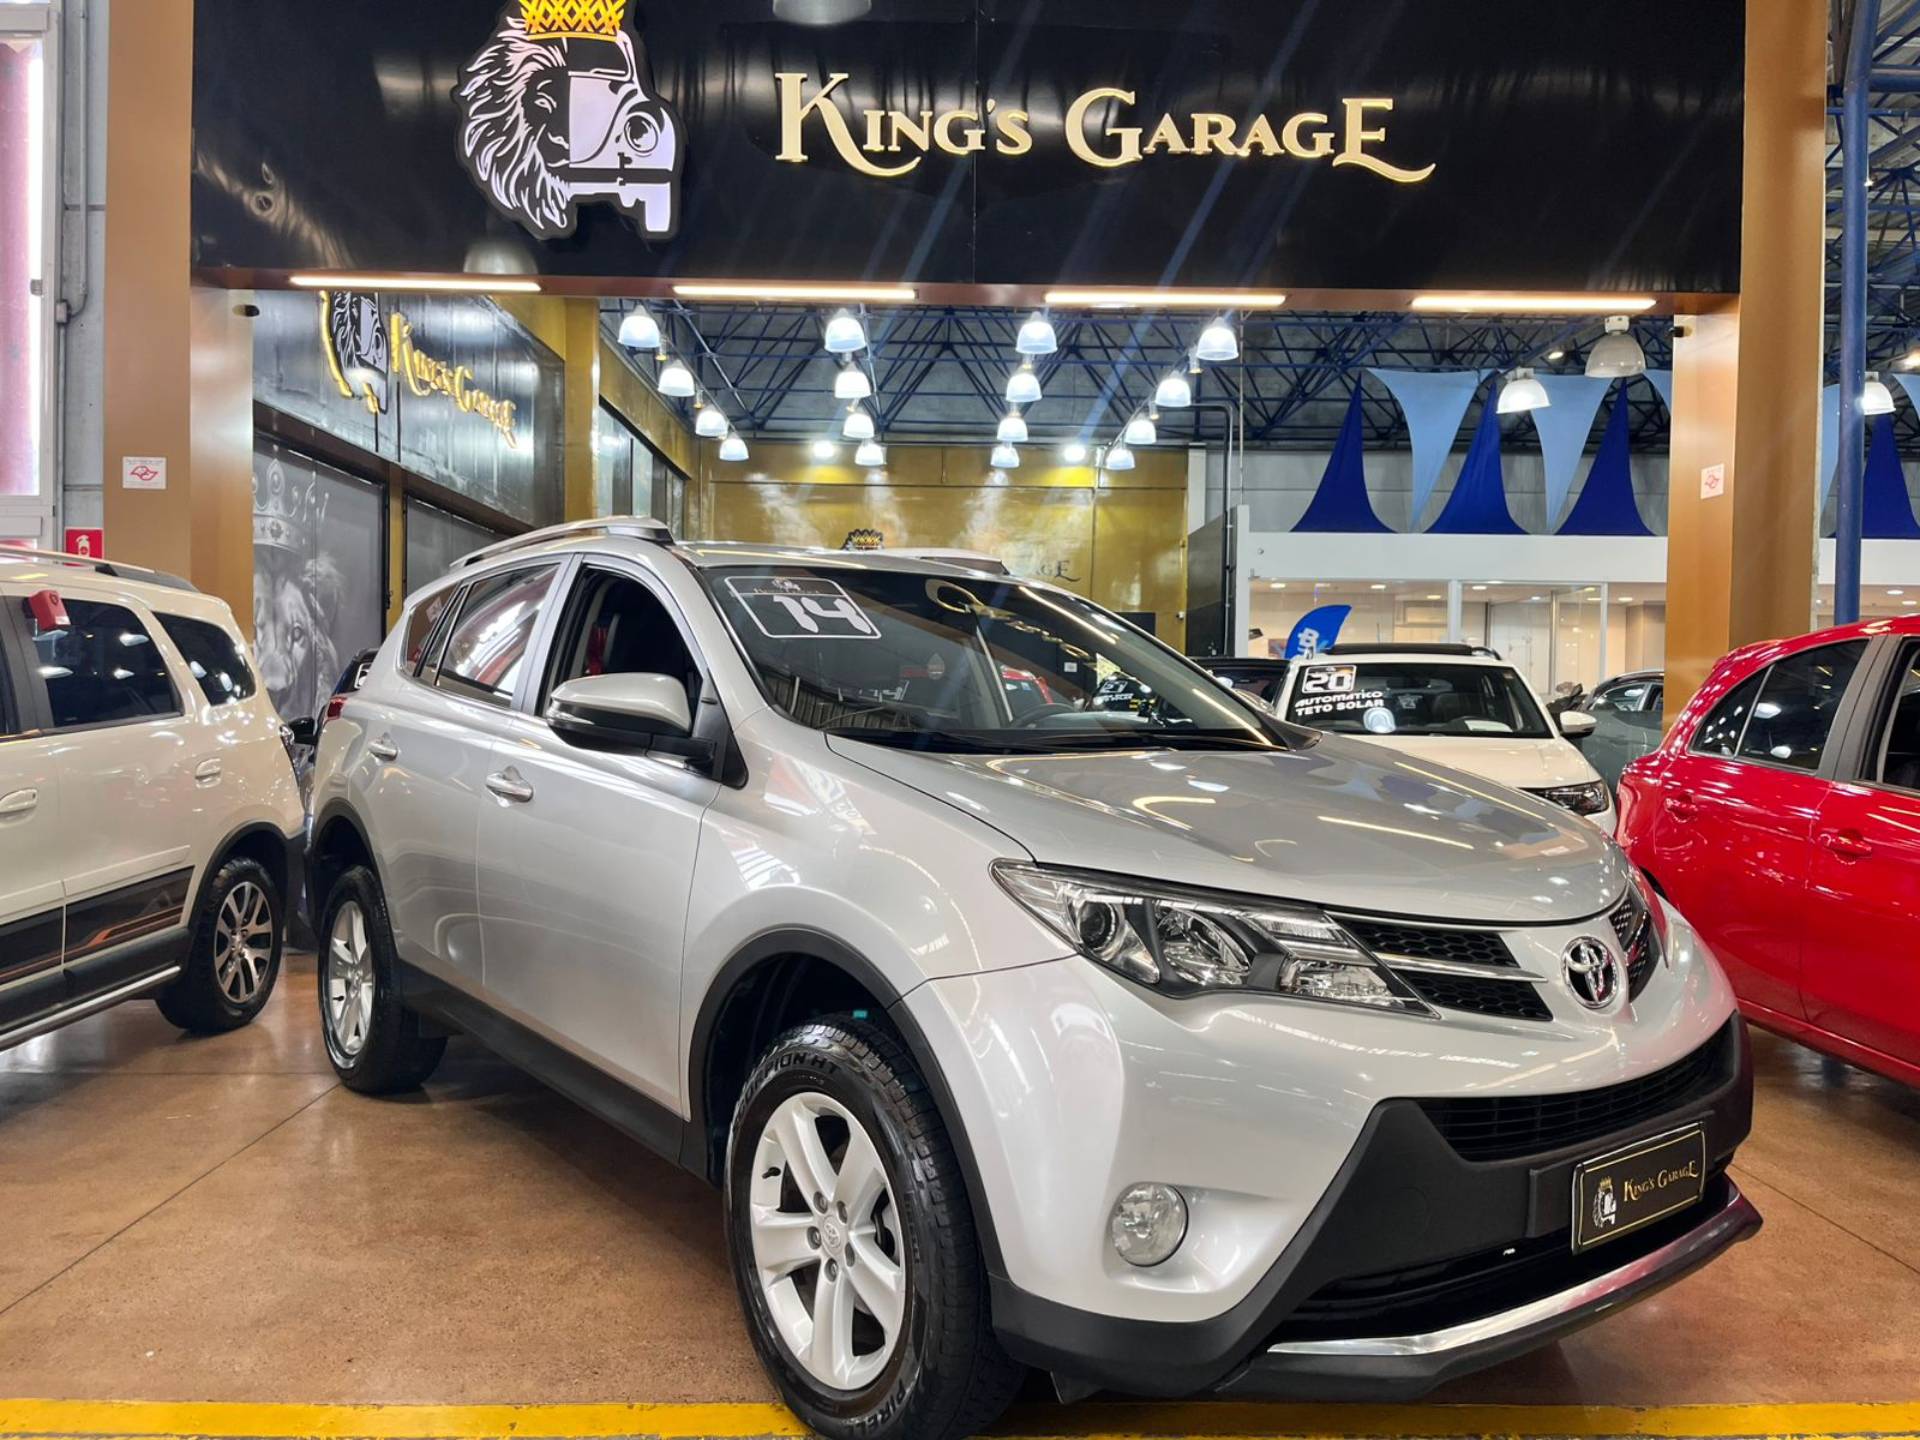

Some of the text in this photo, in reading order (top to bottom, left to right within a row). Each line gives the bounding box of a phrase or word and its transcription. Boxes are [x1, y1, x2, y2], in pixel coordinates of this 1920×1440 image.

[774, 72, 1437, 184] KING'S GARAGE
[773, 595, 872, 634] 14
[1305, 672, 1353, 692] 20
[1295, 699, 1385, 716] TETO SOLAR
[838, 1379, 906, 1438] PIRELL
